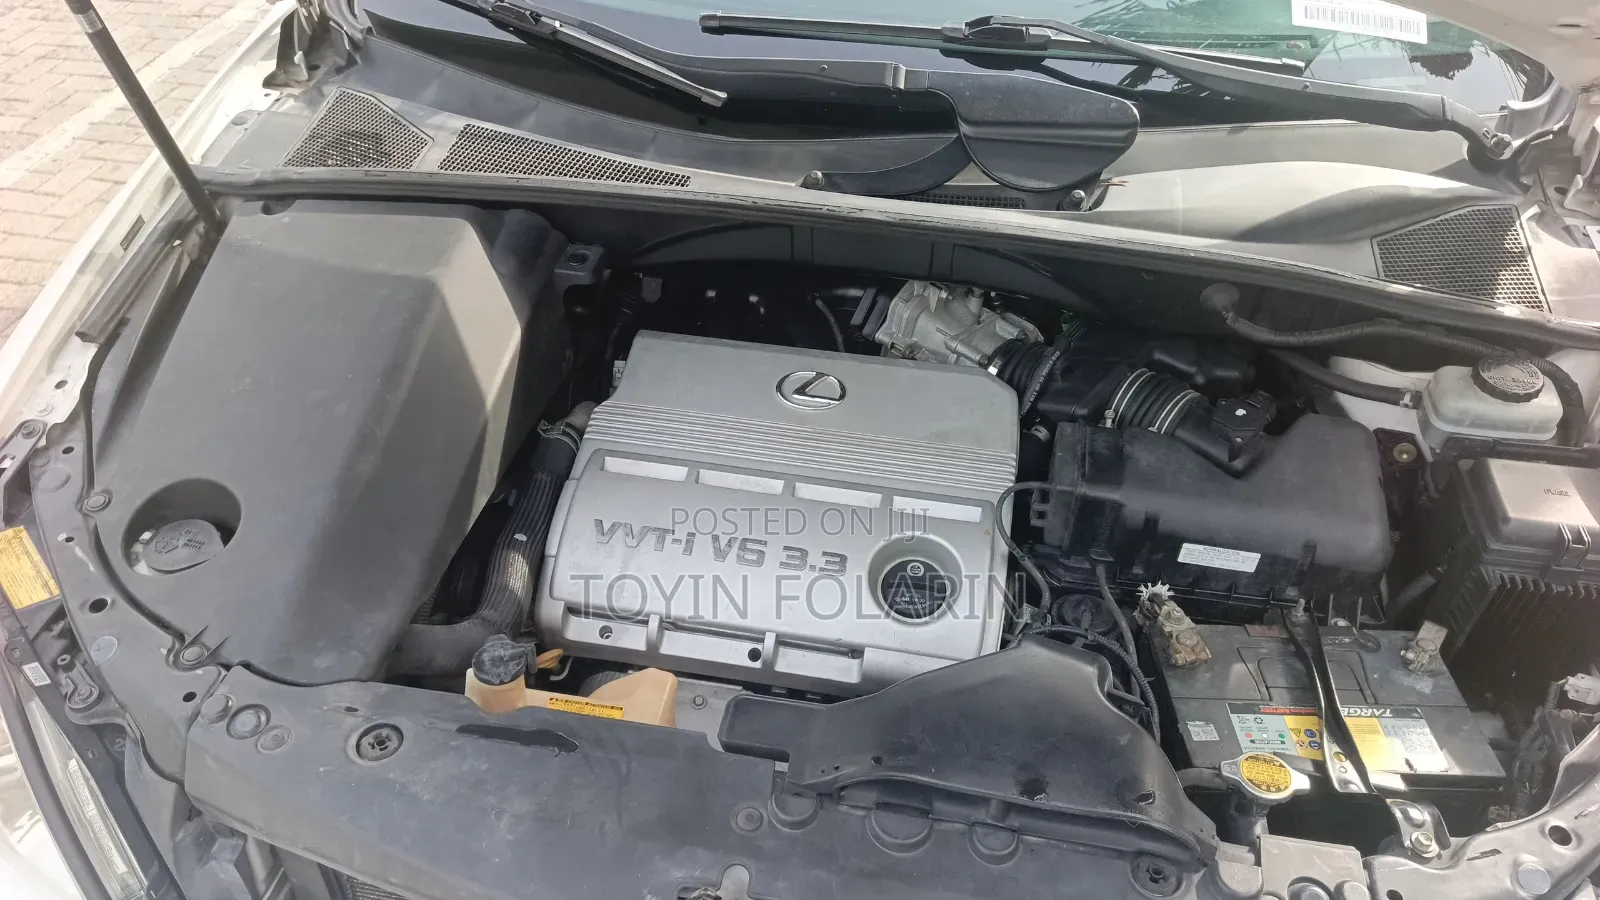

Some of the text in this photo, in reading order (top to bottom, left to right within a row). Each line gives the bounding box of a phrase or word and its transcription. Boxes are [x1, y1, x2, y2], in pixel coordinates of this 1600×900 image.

[593, 518, 848, 577] VVT-i V6 3.3
